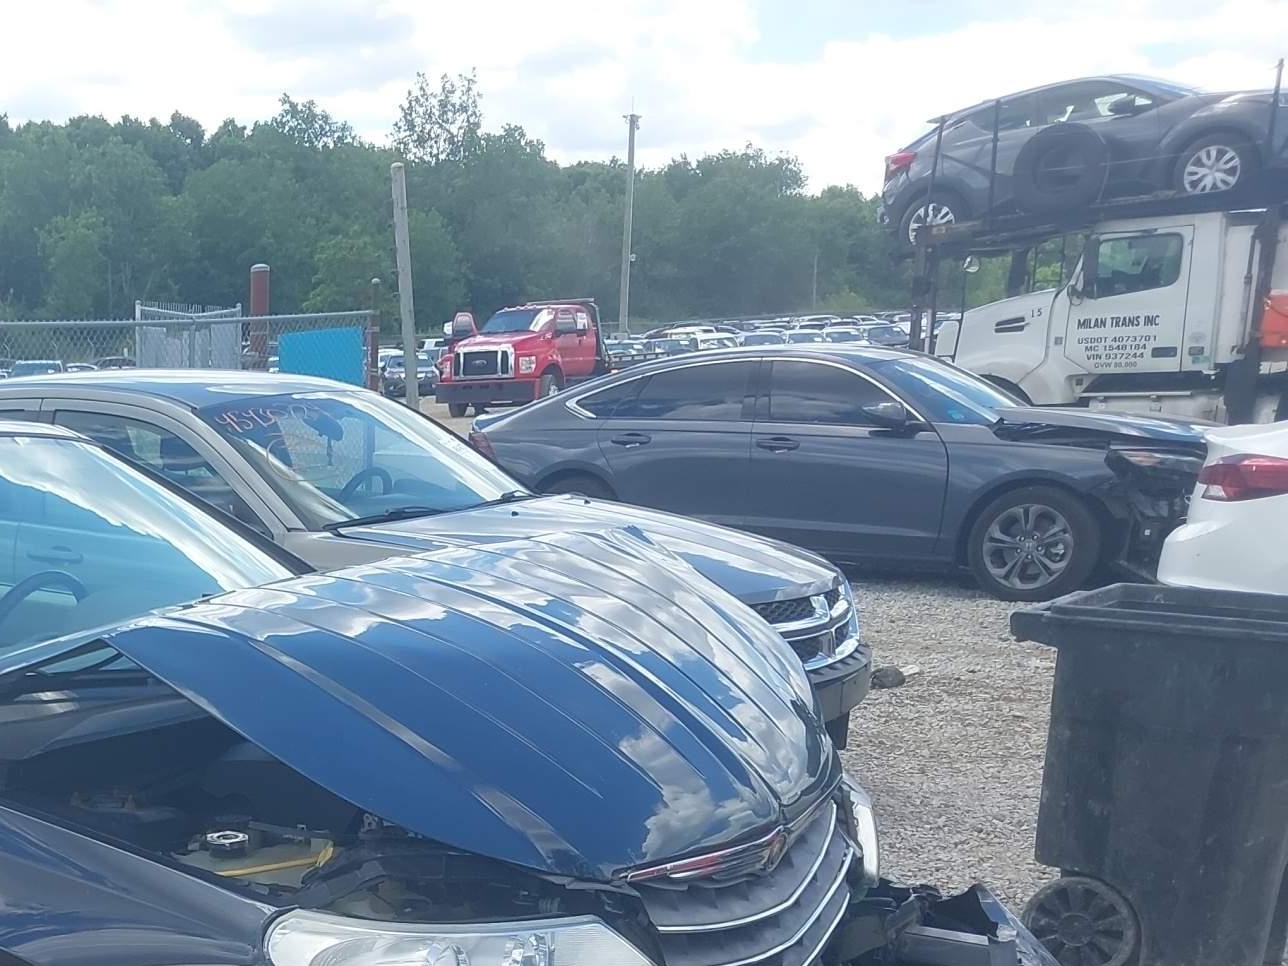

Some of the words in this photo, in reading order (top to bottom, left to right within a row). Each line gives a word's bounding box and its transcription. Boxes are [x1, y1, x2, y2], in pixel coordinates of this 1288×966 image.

[1077, 317, 1108, 330] MILAN
[1110, 315, 1141, 328] TRANS
[1143, 314, 1160, 327] INC
[1077, 336, 1109, 345] USDOT
[1111, 334, 1157, 343] 4073701
[1086, 353, 1102, 361] VIN
[1104, 352, 1145, 360] 937244
